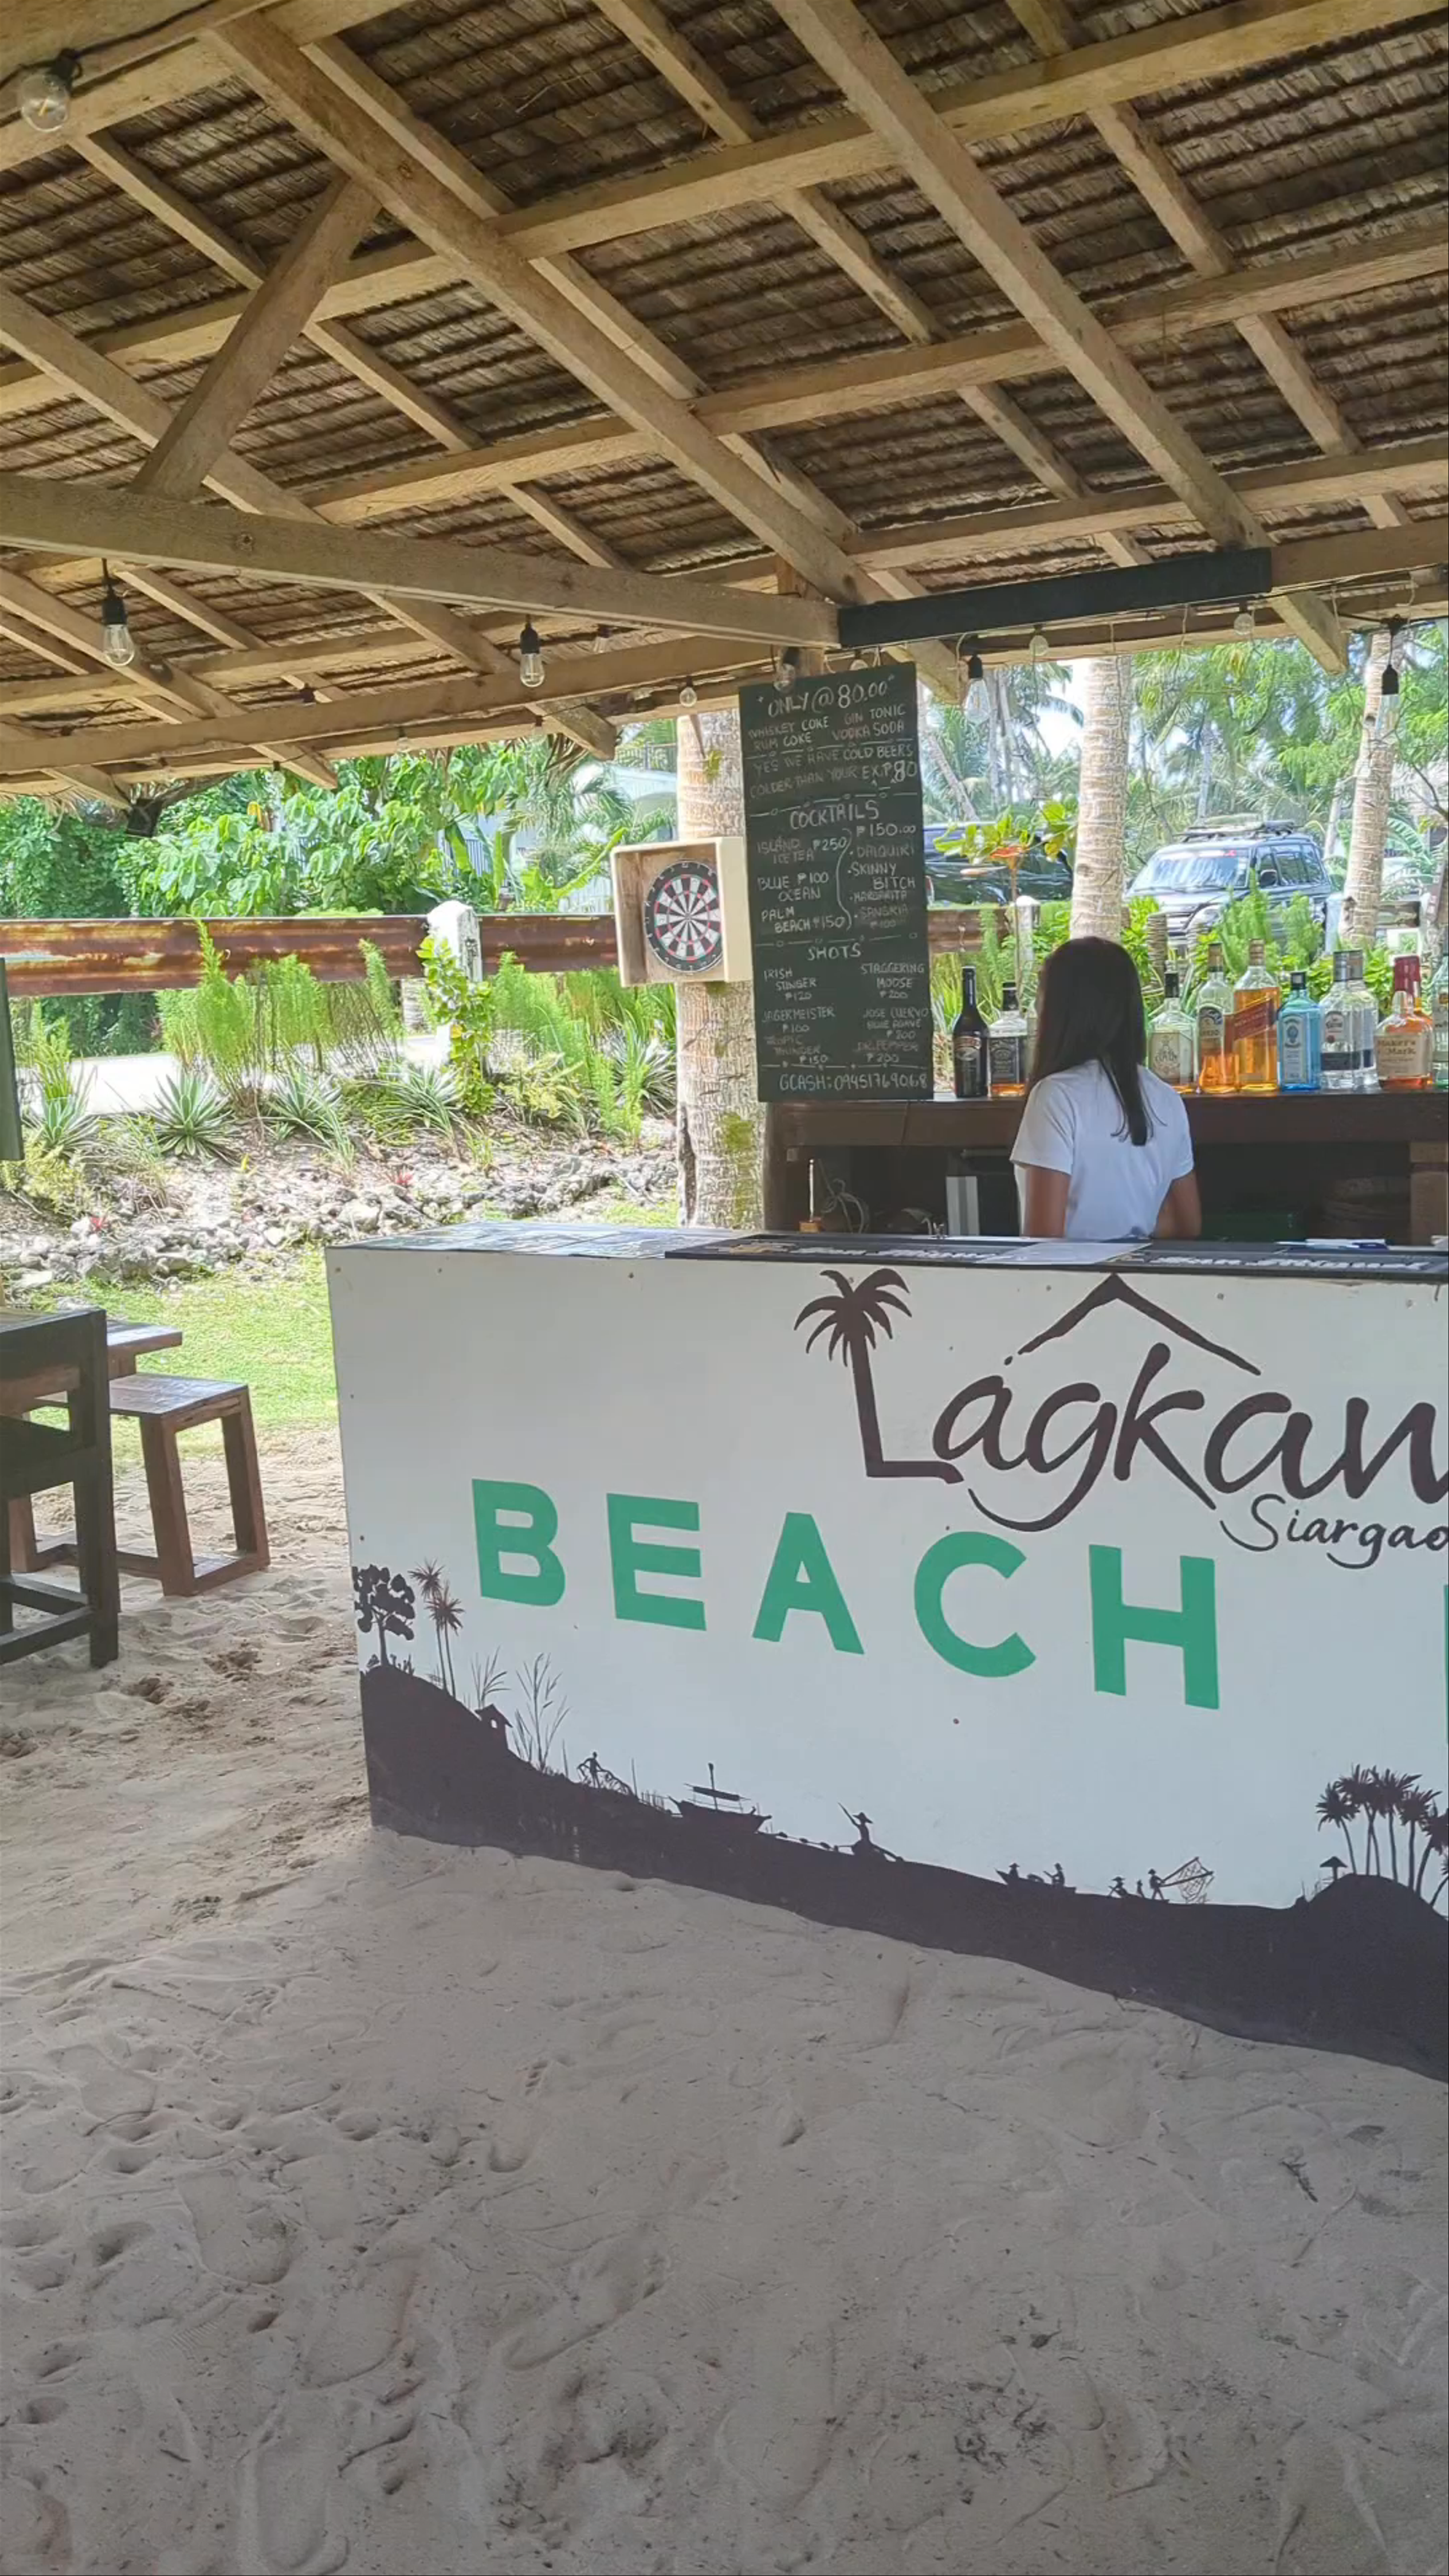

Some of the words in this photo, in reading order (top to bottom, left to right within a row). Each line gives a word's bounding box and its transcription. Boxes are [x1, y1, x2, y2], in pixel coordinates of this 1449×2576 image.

[844, 713, 863, 725] GIN
[869, 703, 907, 719] TONIC
[748, 722, 795, 740] WHISKEY
[801, 715, 829, 731] COKE
[831, 724, 871, 741] VODKA
[872, 719, 904, 737] SODA
[753, 738, 778, 752] RUM
[783, 732, 813, 747] COKE
[753, 760, 778, 774] YES
[784, 755, 802, 767] WE
[807, 749, 840, 764] HAVE
[843, 747, 874, 760] COLD
[877, 744, 914, 759] BEERS
[750, 777, 793, 799] COLDER
[794, 772, 824, 788] THAN
[826, 765, 857, 782] YOUR
[789, 800, 880, 829] COCKTAILS
[756, 837, 801, 854] ISLAND
[856, 844, 915, 858] DAIQUIRI
[773, 854, 791, 864] ICE
[793, 849, 814, 862] TEA
[851, 861, 896, 877] SKINNY
[757, 875, 790, 891] BLUE
[873, 876, 916, 890] BITCH
[778, 886, 821, 902] OCEAN
[761, 906, 795, 923] PALM
[774, 917, 811, 934] BEACH
[806, 943, 861, 961] SHOTS
[764, 967, 793, 982] IRISH
[860, 963, 924, 975] STAGGERING
[775, 977, 818, 992] STINGER
[877, 978, 912, 989] MOOSE
[863, 1008, 886, 1018] JOSE
[890, 1007, 929, 1019] CUERVO
[472, 1478, 1220, 1709] BEACH
